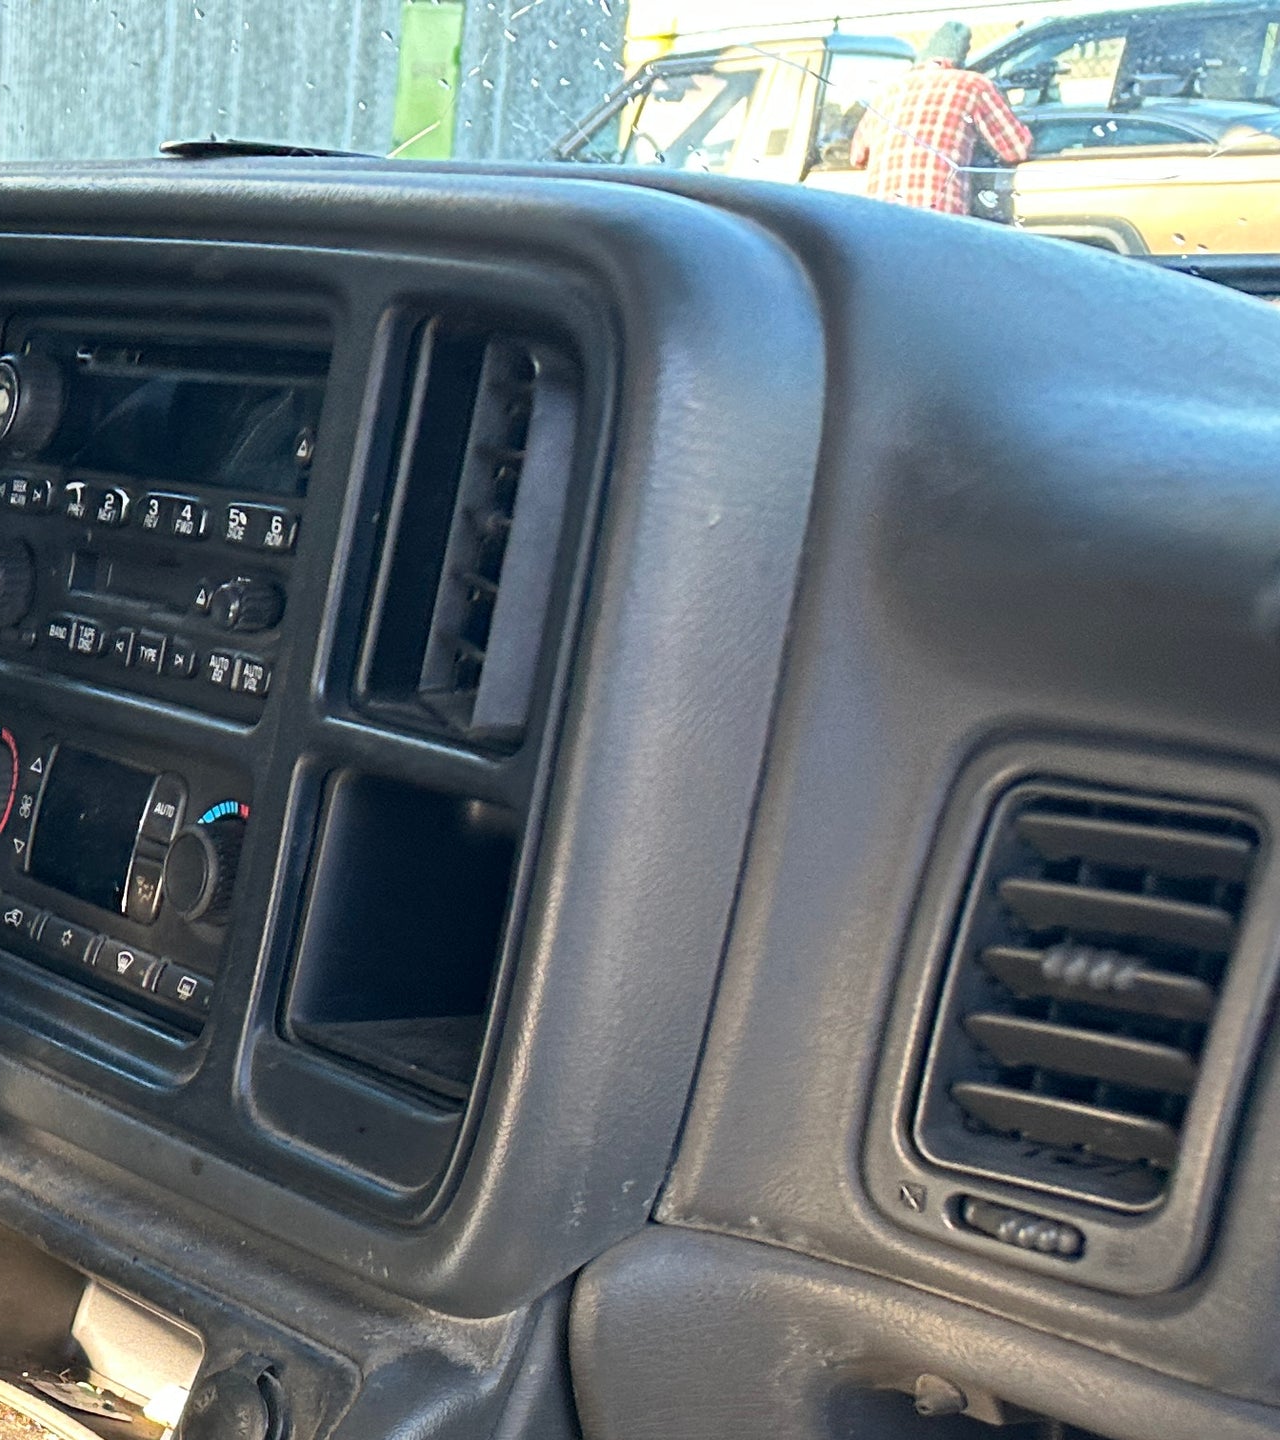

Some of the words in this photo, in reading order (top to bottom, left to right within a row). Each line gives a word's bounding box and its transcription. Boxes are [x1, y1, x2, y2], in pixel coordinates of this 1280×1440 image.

[104, 493, 116, 510] 2
[148, 499, 159, 516] 3
[180, 504, 193, 521] 4
[228, 508, 240, 527] 5
[173, 518, 194, 535] FWD
[270, 515, 283, 534] 6
[48, 624, 68, 641] BAND
[79, 625, 97, 641] TAPE
[139, 644, 159, 664] TYPE
[209, 654, 231, 673] AUTO
[243, 662, 265, 681] AUTO
[153, 801, 176, 818] AUTO
